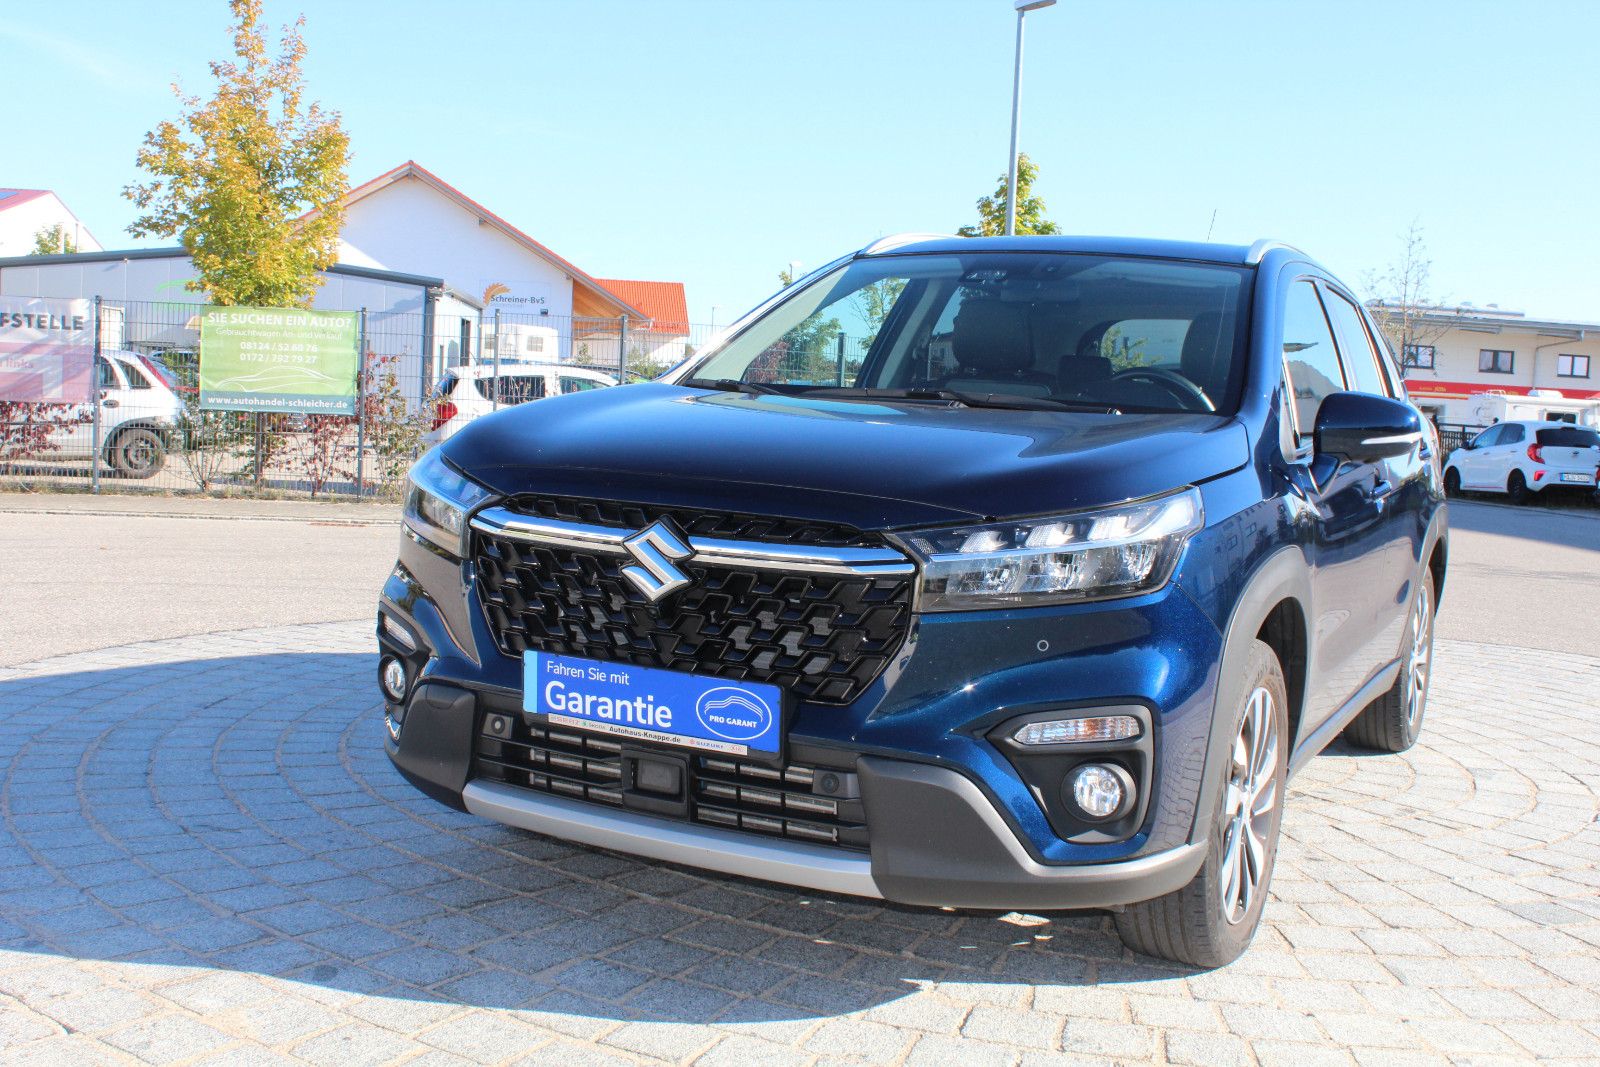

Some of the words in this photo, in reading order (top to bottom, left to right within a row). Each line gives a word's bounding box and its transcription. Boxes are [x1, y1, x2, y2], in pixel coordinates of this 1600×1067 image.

[490, 294, 545, 305] Schreiner-BvS
[208, 312, 227, 324] SIE
[231, 313, 282, 326] SUCHEN
[287, 315, 307, 327] EIN
[310, 316, 351, 328] AUTO?
[208, 396, 348, 409] www.autohandel-schleicher.de
[547, 660, 584, 679] Fahren
[588, 667, 606, 682] Sie
[610, 671, 630, 686] mit
[545, 680, 673, 728] Garantie
[709, 714, 725, 724] PRO
[726, 717, 758, 728] GARANT
[609, 725, 681, 743] Autohaus-Knappe.de
